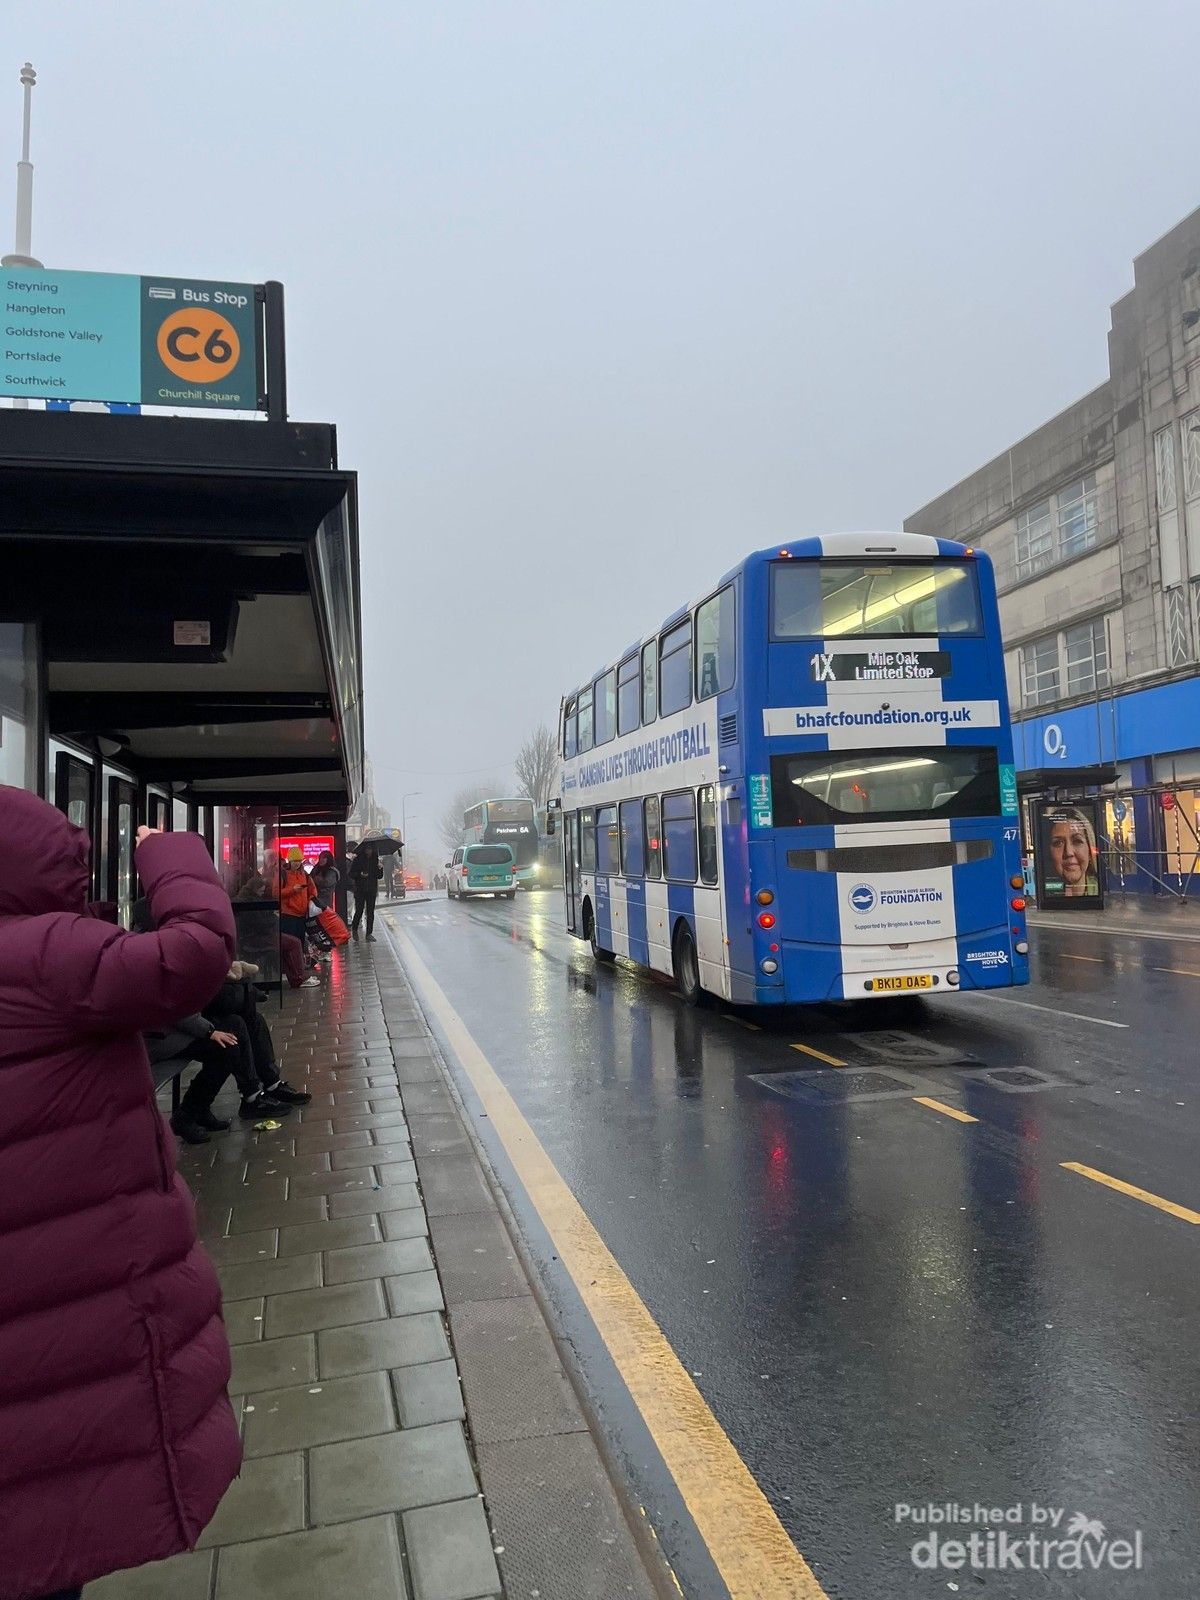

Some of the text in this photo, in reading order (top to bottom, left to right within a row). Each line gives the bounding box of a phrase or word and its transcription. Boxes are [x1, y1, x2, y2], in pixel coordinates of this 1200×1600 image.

[7, 280, 58, 295] Steyning
[182, 288, 248, 309] Bus Stop
[6, 303, 66, 315] Hangleton
[5, 326, 103, 343] Goldstone Valley
[166, 326, 232, 364] C6
[5, 350, 62, 363] Portslade
[4, 374, 67, 387] Southwick
[158, 388, 241, 403] Churchill Square
[868, 650, 920, 666] Mile Oak
[810, 653, 837, 681] 1X
[855, 665, 934, 680] Limited Stop
[796, 707, 972, 728] bhafcfoundation.org.uk
[579, 761, 606, 788] CHANGING
[606, 753, 623, 782] LIVES
[623, 739, 659, 777] THROUGH
[660, 722, 711, 767] FOOTBALL
[880, 891, 943, 905] FOUNDATION
[854, 922, 880, 931] Supported
[881, 922, 887, 930] by
[887, 921, 909, 929] Brighton
[967, 951, 997, 959] BRIGHTON
[877, 976, 927, 989] BK13 OAS
